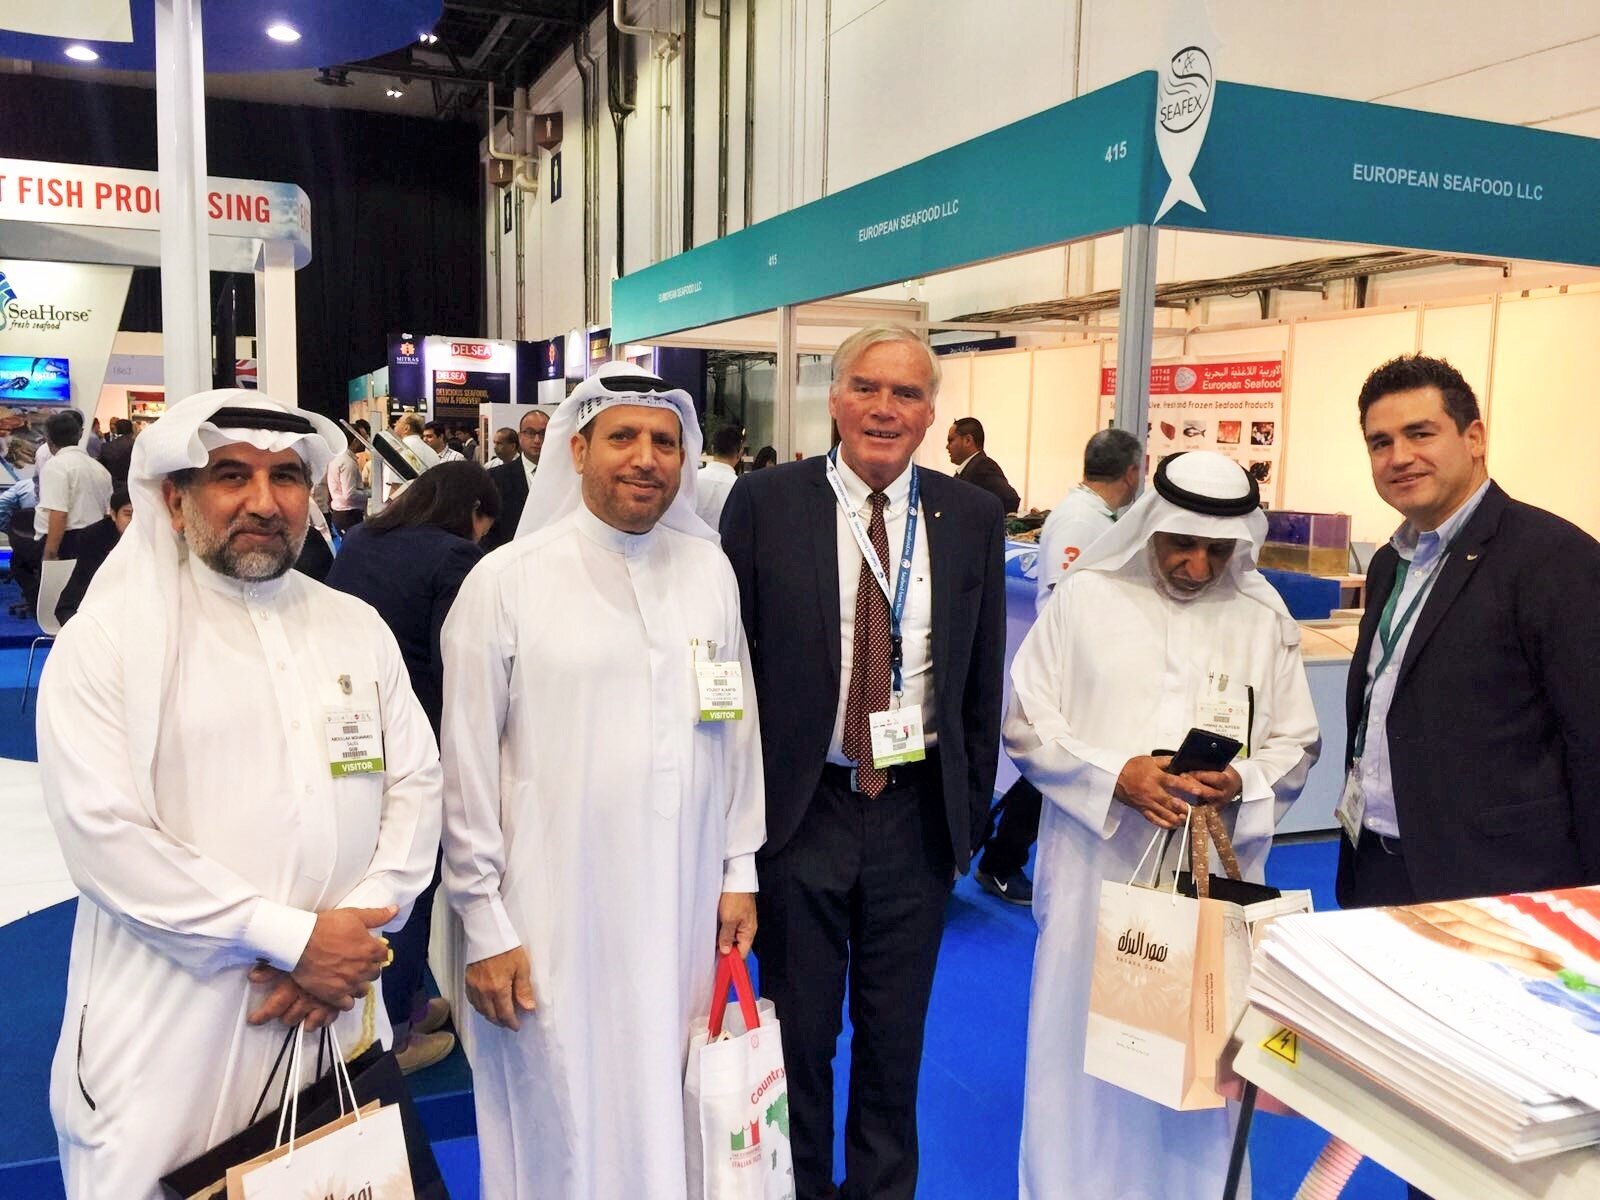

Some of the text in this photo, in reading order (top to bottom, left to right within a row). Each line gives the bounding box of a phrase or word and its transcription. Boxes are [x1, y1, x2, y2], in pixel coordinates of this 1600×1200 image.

[1160, 94, 1202, 122] SEAFEX
[1104, 140, 1127, 162] 415
[1353, 163, 1543, 200] EUROPEAN SEAFOOD LLC
[18, 176, 83, 209] FISH
[858, 199, 959, 242] EUROPEAN SEAFOOD LLC
[9, 319, 61, 332] fresh seafood
[452, 344, 492, 356] DELSEA
[436, 371, 467, 380] DELSEA
[1202, 378, 1282, 392] European Seafood
[1188, 400, 1213, 409] Frozen
[1215, 400, 1243, 409] Seafood
[1244, 400, 1274, 409] Products
[709, 711, 736, 719] VISITOR
[342, 762, 374, 772] VISITOR
[750, 1067, 785, 1105] Country
